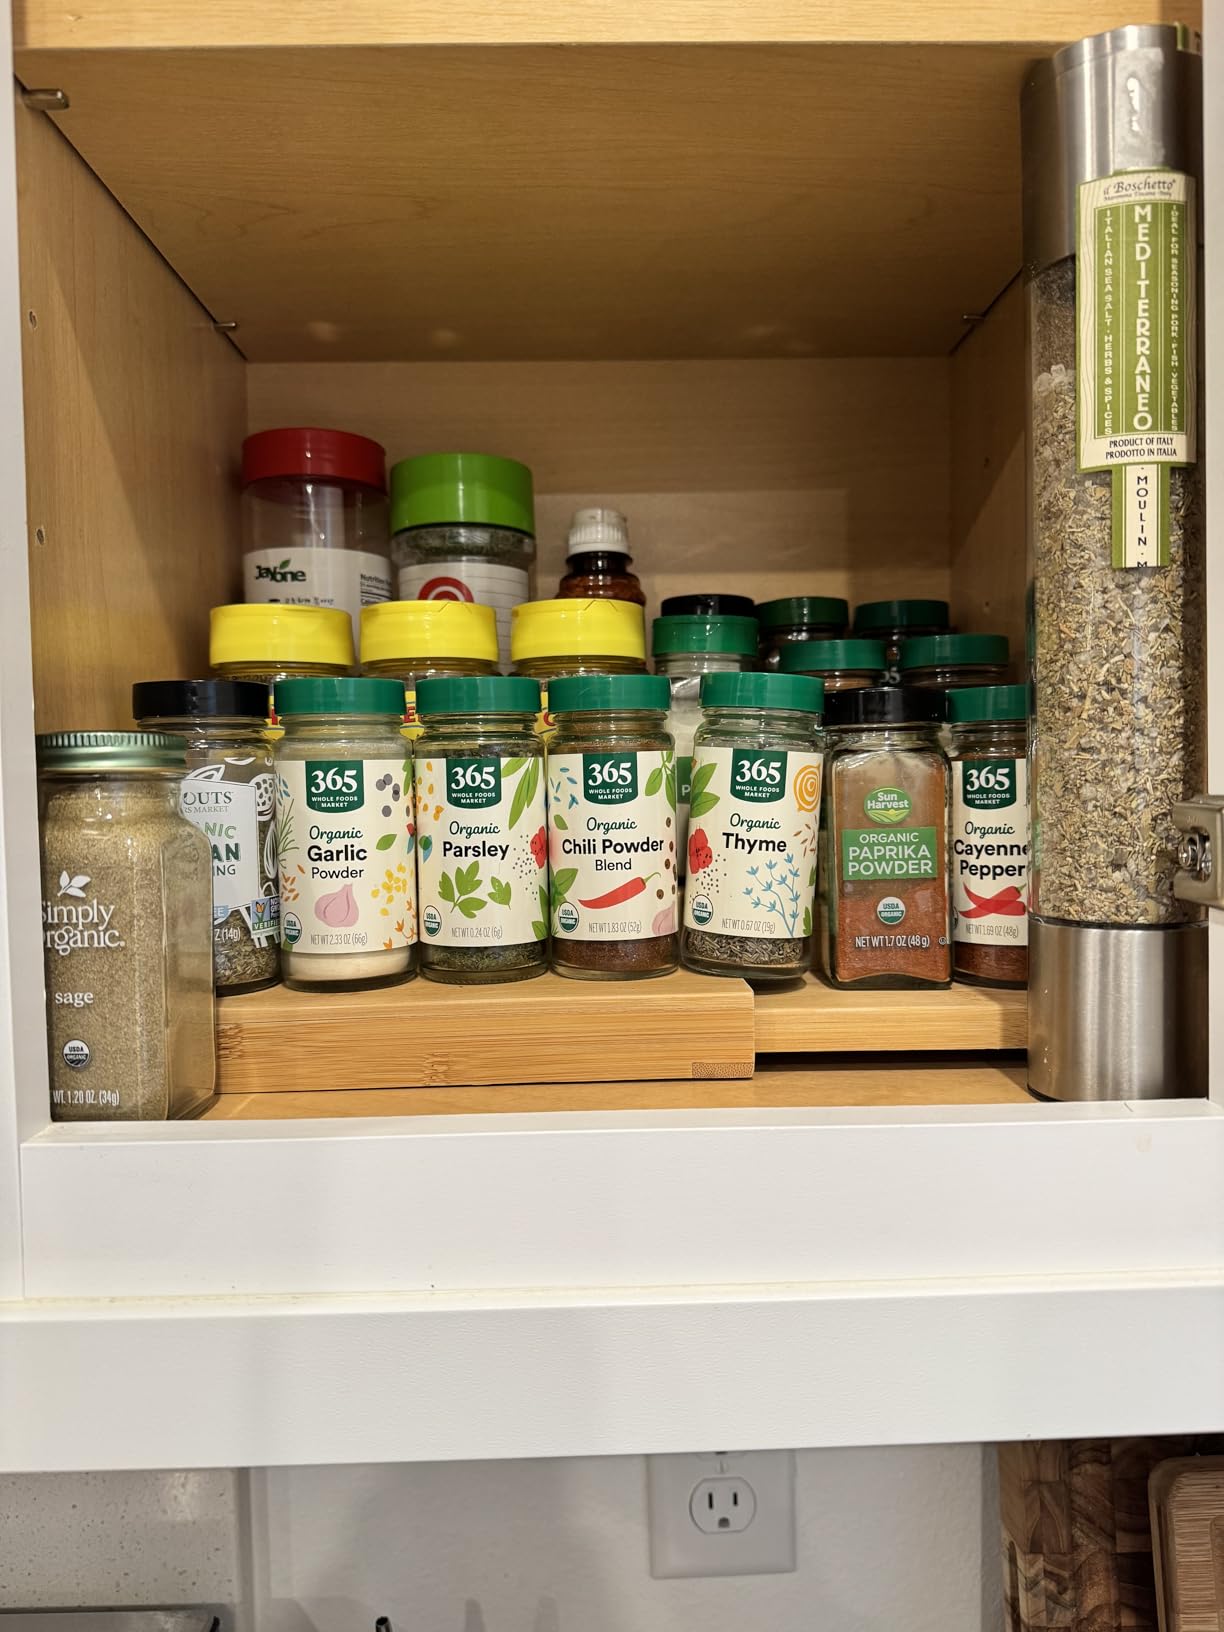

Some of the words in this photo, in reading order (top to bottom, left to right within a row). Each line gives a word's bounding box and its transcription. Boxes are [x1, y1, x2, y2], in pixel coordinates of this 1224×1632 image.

[1113, 176, 1174, 194] Boschetto
[1104, 209, 1113, 266] ITALIAN
[1104, 268, 1113, 293] SEA
[1104, 294, 1113, 326] SALT
[1133, 204, 1152, 431] MEDITERRANEO
[1104, 334, 1112, 375] HERBS
[1104, 387, 1112, 435] SPICES
[1170, 372, 1179, 432] VEGETABLES
[1109, 437, 1143, 448] PRODUCT
[1146, 437, 1155, 446] OF
[1156, 436, 1174, 446] ITALY
[1106, 448, 1145, 460] PRODOTTO
[1147, 448, 1156, 456] IN
[1156, 448, 1178, 457] ITALIA
[1136, 476, 1148, 547] MOULIN
[451, 764, 496, 790] 365
[588, 760, 632, 786] 365
[736, 758, 782, 784] 365
[966, 766, 1010, 791] 365
[310, 767, 358, 794] 365
[184, 791, 232, 805] OUTS
[867, 800, 909, 810] Harvest
[877, 792, 898, 801] Sun
[194, 806, 229, 814] MARKET
[450, 820, 500, 839] Organic
[586, 817, 638, 835] Organic
[730, 813, 782, 832] Organic
[964, 821, 1016, 839] Organic
[309, 825, 364, 844] Organic
[722, 832, 786, 854] Thyme
[859, 832, 919, 844] ORGANIC
[307, 844, 368, 862] Garlic
[442, 840, 510, 860] Parsley
[562, 838, 596, 854] Chili
[602, 836, 664, 854] Powder
[848, 844, 931, 860] PAPRIKA
[311, 866, 364, 880] Powder
[595, 858, 632, 871] Blend
[848, 860, 933, 876] POWDER
[960, 860, 1026, 880] Pepper
[222, 928, 240, 941] (14g)
[452, 927, 461, 938] NET
[462, 927, 469, 938] WT
[470, 927, 482, 938] 0.24
[484, 926, 490, 937] OZ
[492, 926, 503, 940] (6g)
[588, 922, 599, 933] NET
[600, 922, 607, 933] WT
[608, 922, 619, 933] 1.83
[620, 922, 626, 932] OZ
[628, 920, 642, 934] (52g)
[722, 918, 732, 929] NET
[732, 919, 740, 930] WT
[740, 920, 753, 931] 0.67
[754, 921, 762, 932] OZ
[762, 921, 776, 934] (19g)
[966, 924, 974, 934] NET
[974, 924, 982, 935] WT
[982, 925, 994, 936] 1.69
[994, 925, 1002, 936] OZ
[1002, 924, 1018, 938] (48g)
[44, 926, 126, 956] rganic.
[310, 934, 320, 945] NET
[321, 934, 329, 945] WT
[330, 934, 343, 945] 2.33
[344, 934, 351, 944] OZ
[352, 932, 368, 946] (66g)
[856, 936, 870, 948] NET
[871, 936, 883, 948] WT
[885, 936, 896, 947] 1.7
[896, 935, 907, 947] OZ
[54, 992, 94, 1008] sage
[53, 1090, 66, 1104] WT.
[68, 1090, 84, 1104] 1.20
[98, 1089, 120, 1106] (34g)
